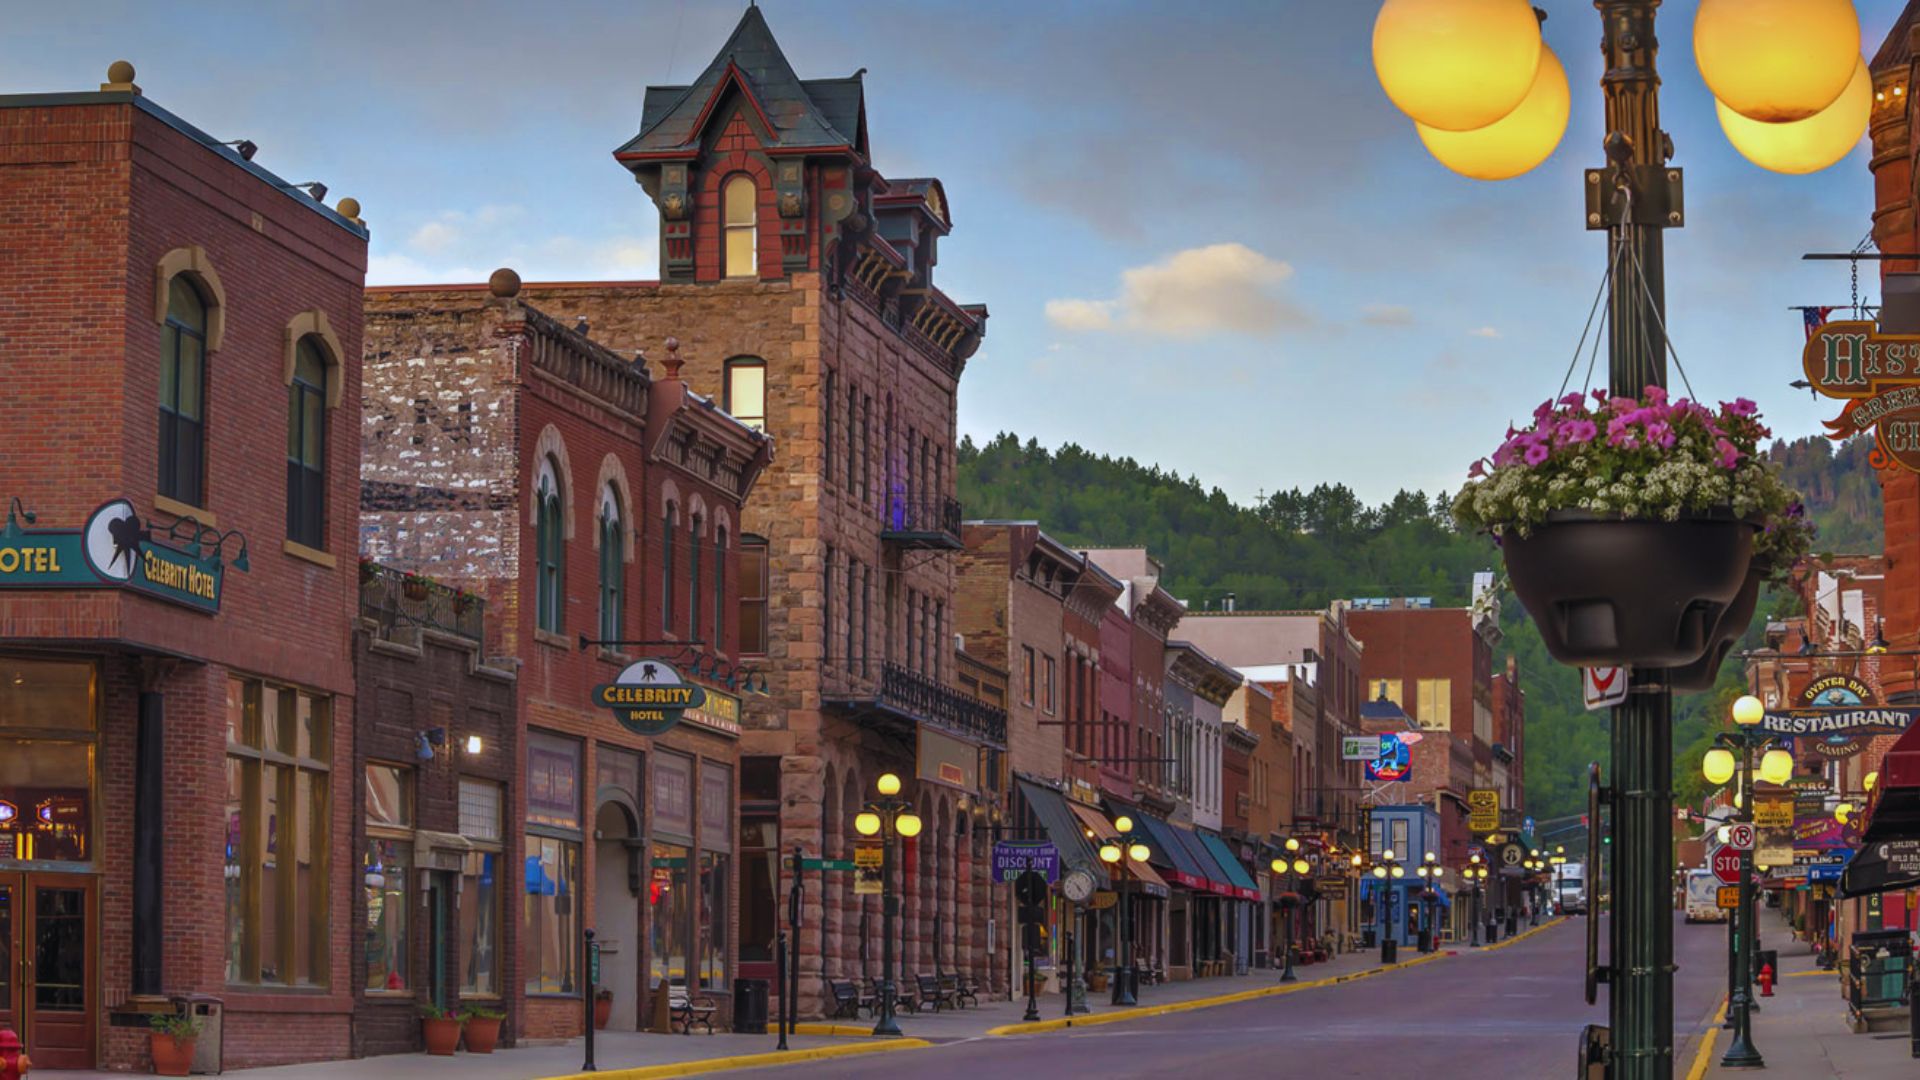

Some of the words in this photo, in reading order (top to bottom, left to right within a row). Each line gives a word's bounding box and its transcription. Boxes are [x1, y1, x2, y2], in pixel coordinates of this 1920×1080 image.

[0, 547, 60, 573] OTEL
[145, 550, 187, 592] CELEBRITY
[188, 564, 215, 599] HOTEL
[603, 687, 693, 703] CELEBRITY
[1804, 677, 1845, 699] OYSTER
[1848, 680, 1870, 698] BAY
[630, 710, 664, 720] HOTEL
[1764, 710, 1910, 733] RESTAURANT
[1816, 742, 1860, 756] GAMING
[1716, 856, 1741, 872] STO
